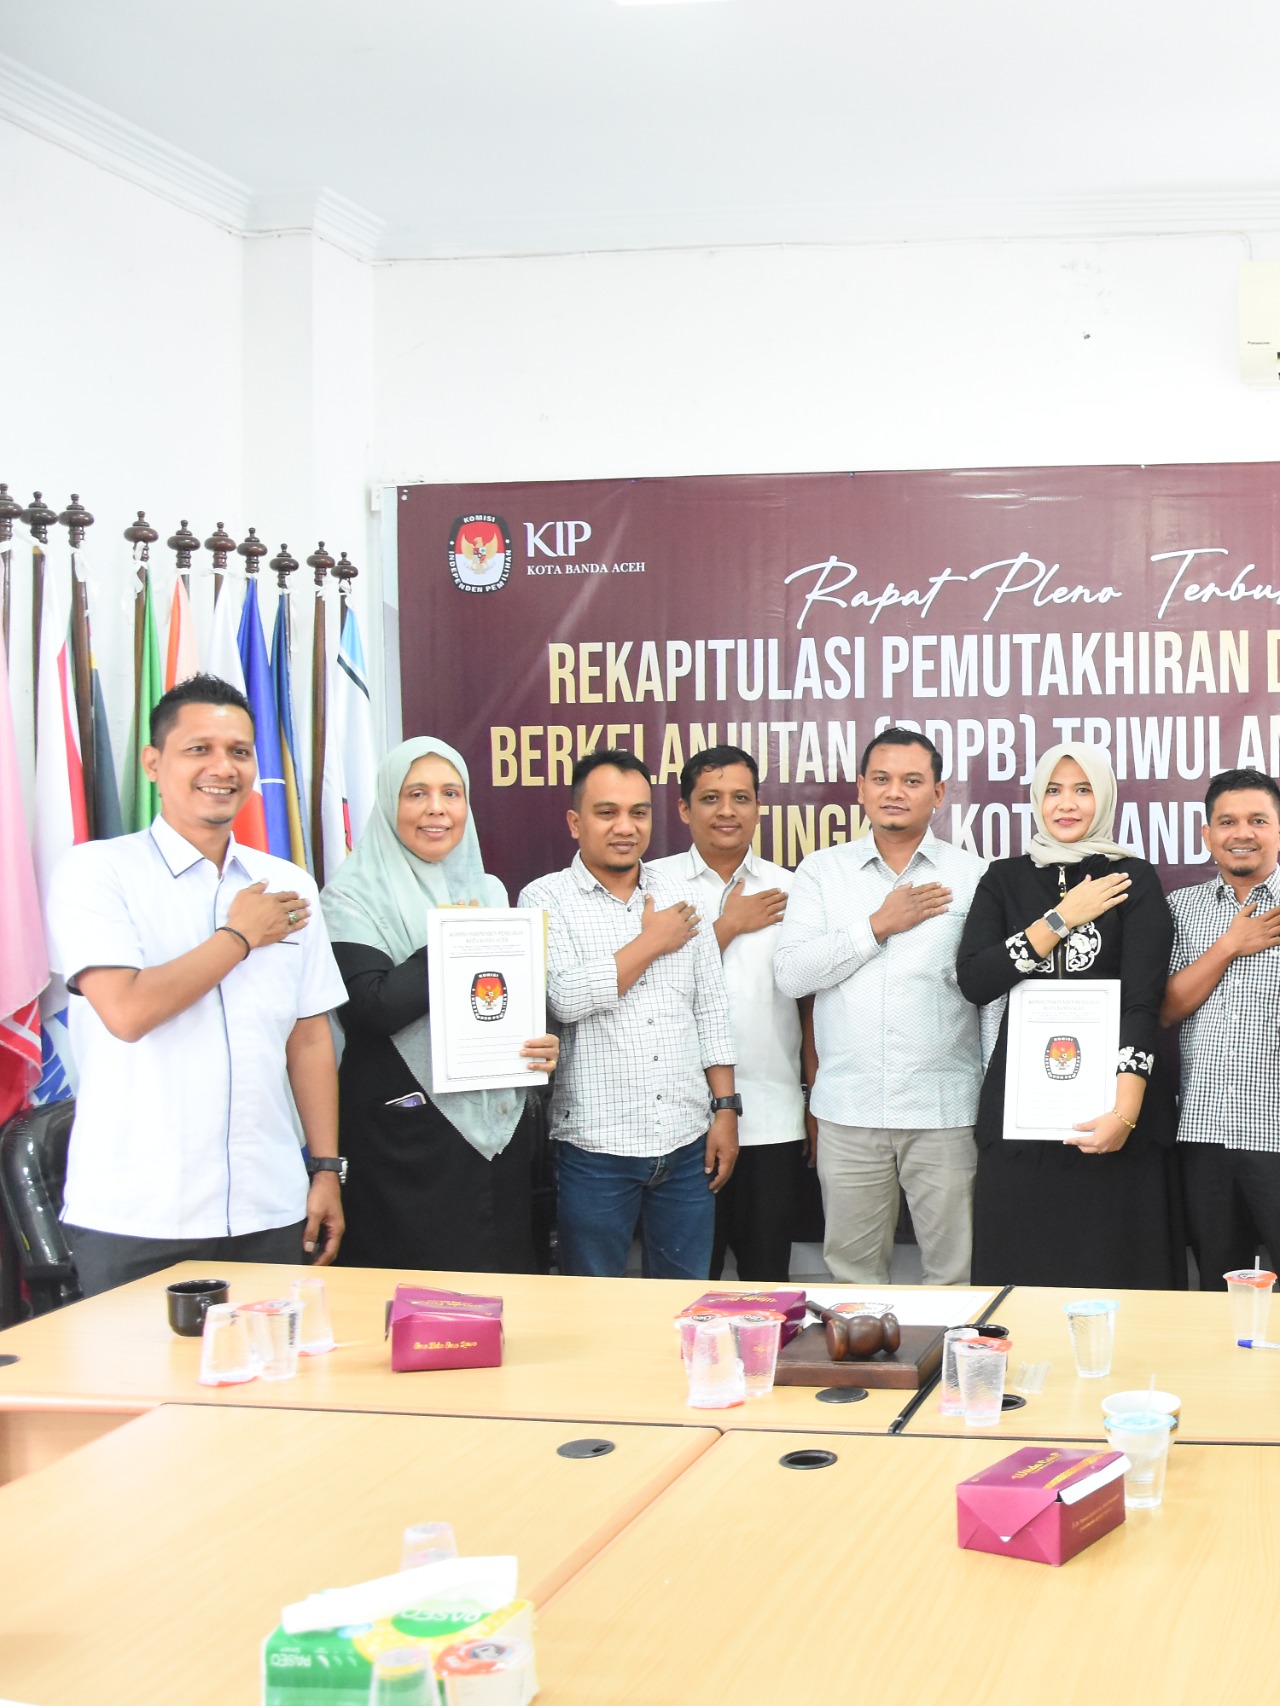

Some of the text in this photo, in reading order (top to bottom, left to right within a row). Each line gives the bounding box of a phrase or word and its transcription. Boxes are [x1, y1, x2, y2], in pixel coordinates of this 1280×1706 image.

[463, 514, 496, 523] KOMISI
[523, 520, 592, 557] KIP
[448, 550, 512, 592] INDEPENDEN PEMILIHAN
[527, 562, 646, 575] KOTA BANDA ACEH
[784, 555, 968, 630] Rapat
[969, 552, 1122, 622] Pleno
[548, 635, 866, 704] REKAPITULASI
[882, 627, 1250, 698] PEMUTAKHIRAN
[874, 714, 1036, 786] DPB)
[752, 804, 874, 867] TING
[952, 802, 1034, 862] KOT
[1117, 802, 1212, 865] AND
